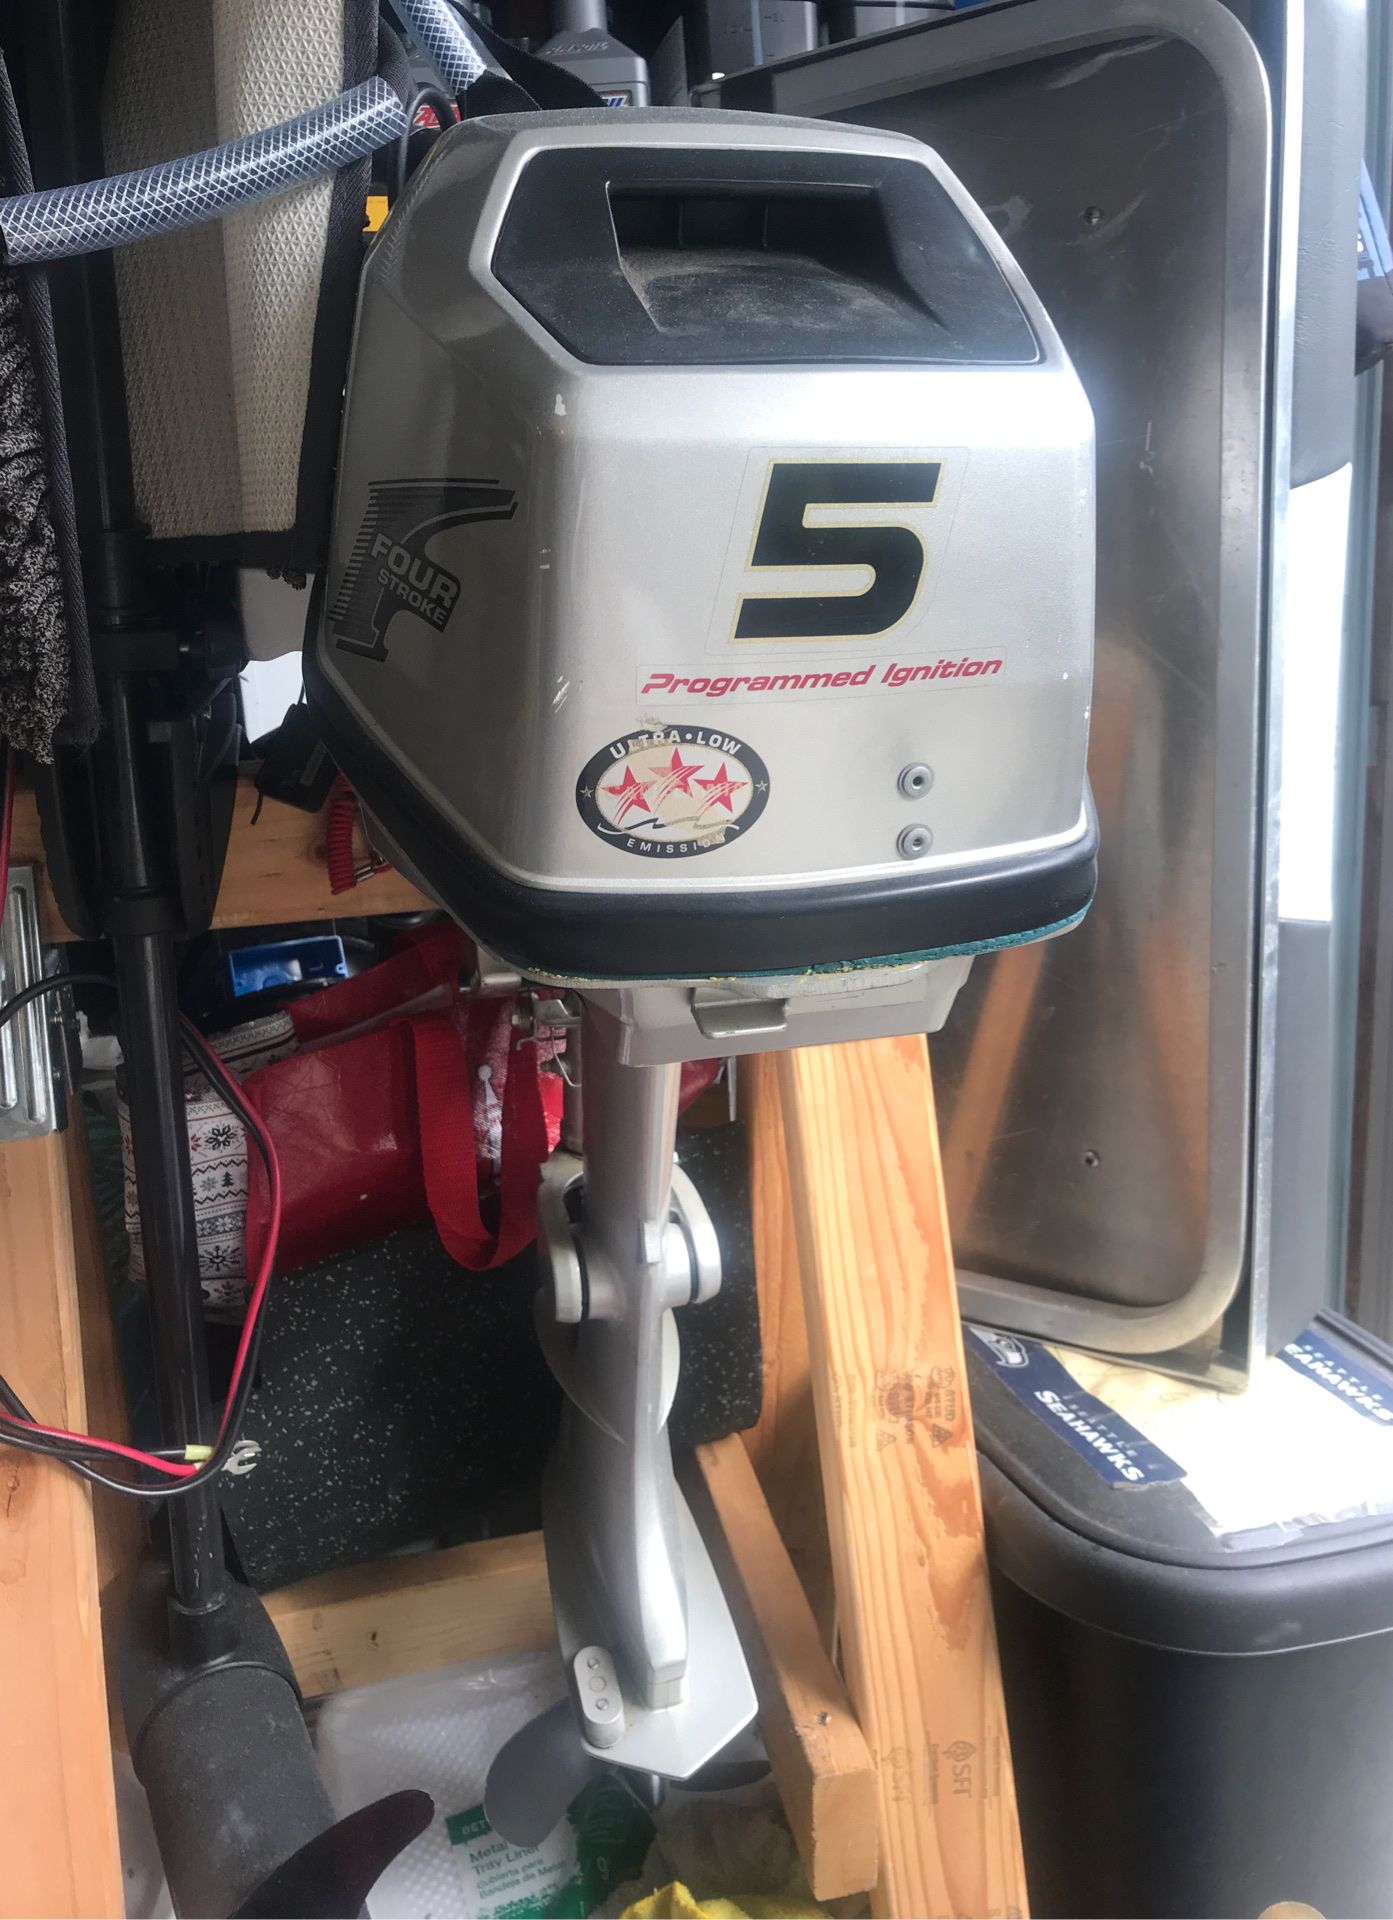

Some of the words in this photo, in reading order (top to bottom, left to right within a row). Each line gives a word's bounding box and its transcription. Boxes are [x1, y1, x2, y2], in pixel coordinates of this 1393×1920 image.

[371, 533, 458, 608] FOUR
[729, 457, 947, 644] 5
[378, 568, 447, 625] STROKE
[641, 664, 876, 697] Programmed
[880, 657, 1003, 687] Ignition
[1284, 1343, 1393, 1421] EAHAWKS
[1034, 1390, 1144, 1481] SEAHAWKS
[469, 1841, 509, 1863] Metal
[472, 1859, 502, 1876] Tray
